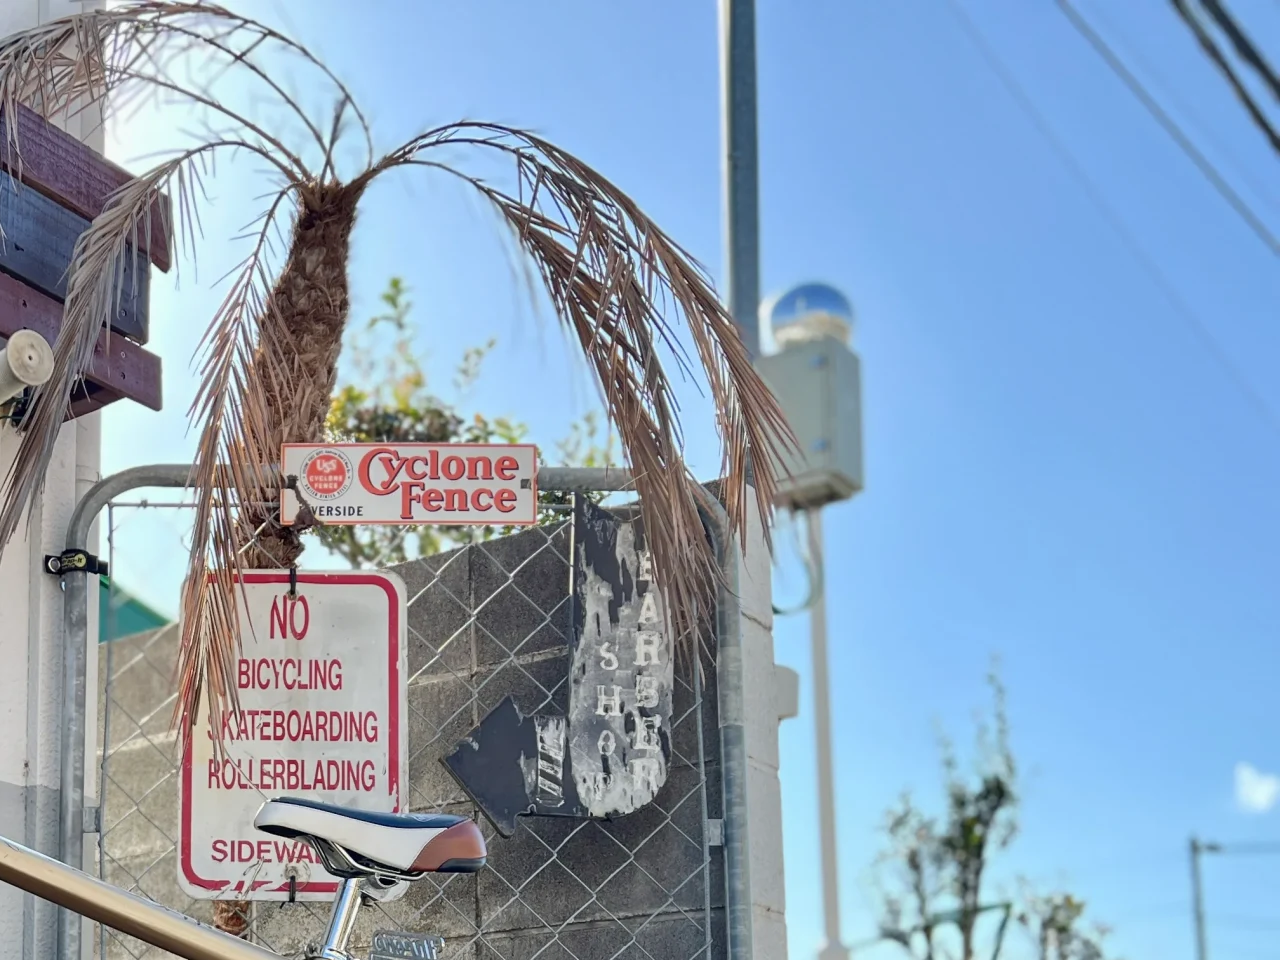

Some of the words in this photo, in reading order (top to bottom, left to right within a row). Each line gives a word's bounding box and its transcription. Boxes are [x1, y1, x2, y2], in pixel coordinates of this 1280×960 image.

[358, 447, 519, 496] Cyclone
[310, 505, 363, 517] VERSIDE
[400, 481, 517, 519] Fence
[269, 594, 310, 641] NO
[237, 658, 343, 691] BICYCLING
[207, 758, 377, 792] ROLLERBLADING
